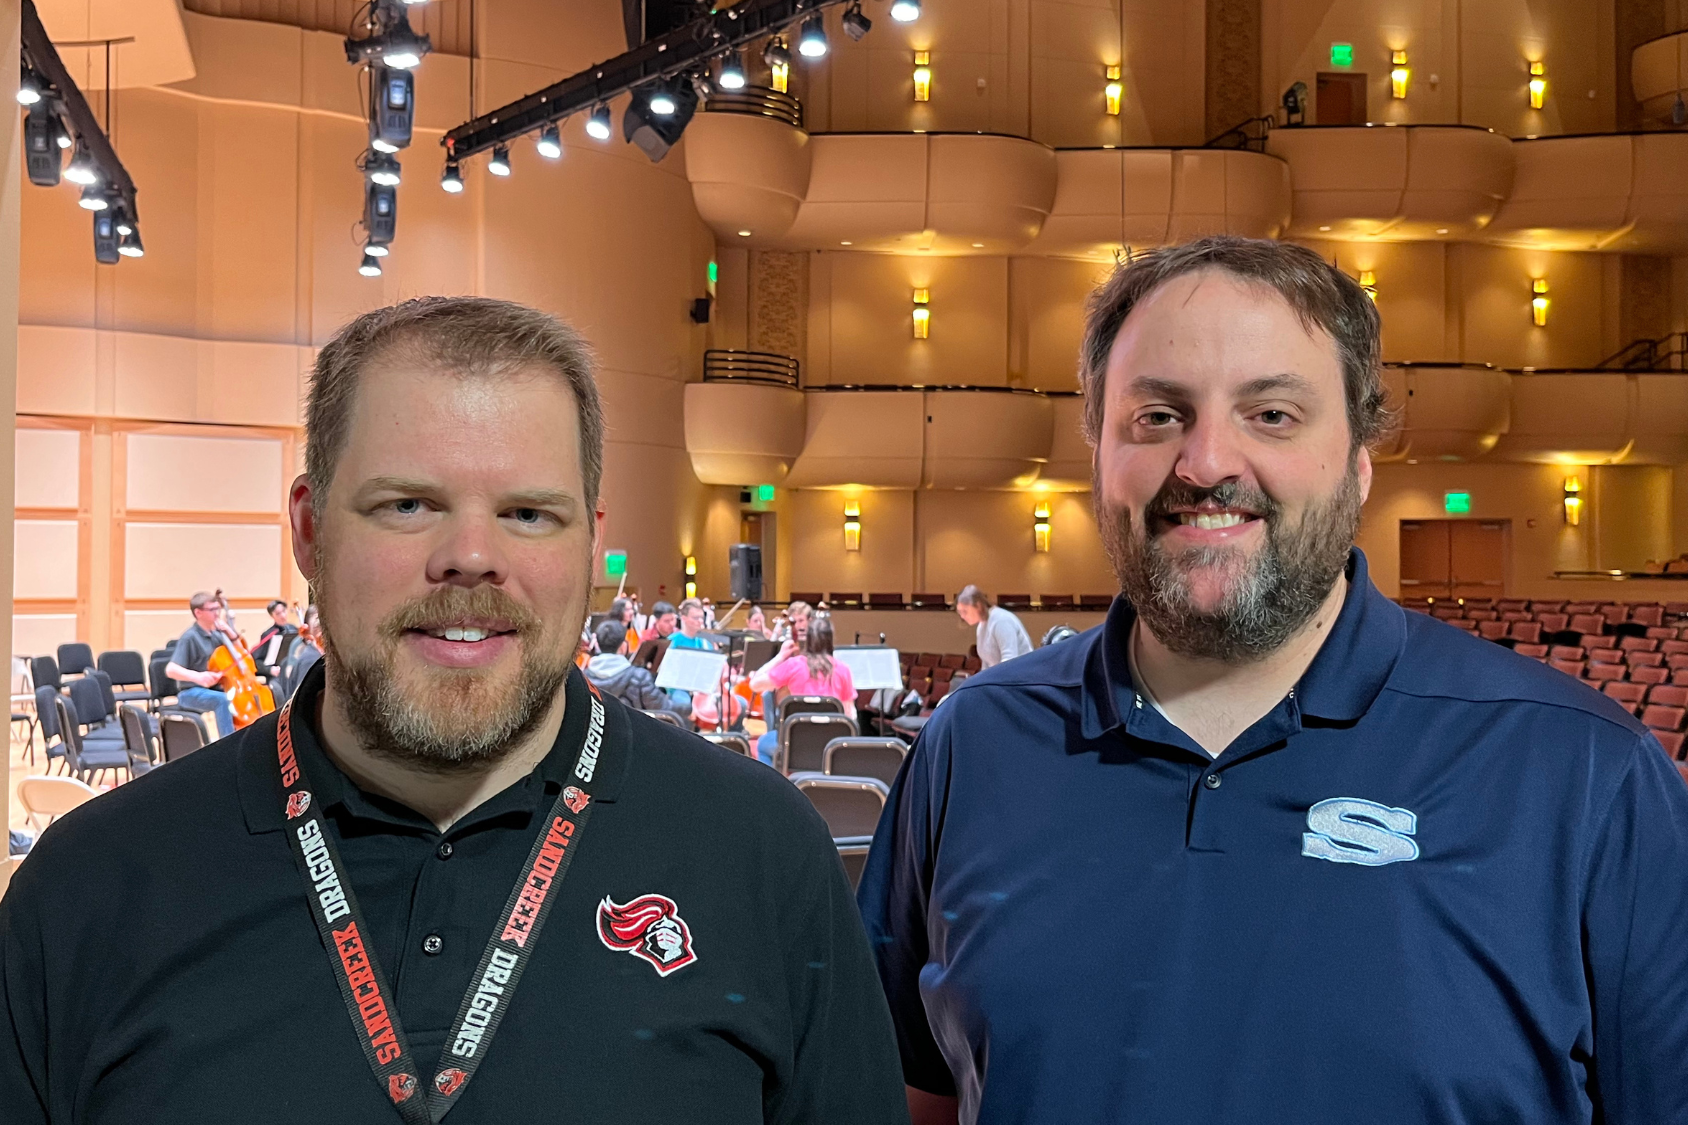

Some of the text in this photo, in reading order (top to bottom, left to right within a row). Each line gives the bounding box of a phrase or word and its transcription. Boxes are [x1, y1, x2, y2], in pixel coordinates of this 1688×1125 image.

[575, 696, 605, 783] DRAGONS
[1301, 797, 1419, 867] S
[297, 819, 401, 1065] SANDCREEK DRAGONS
[451, 815, 575, 1059] SANDCREEK DRAGONS
